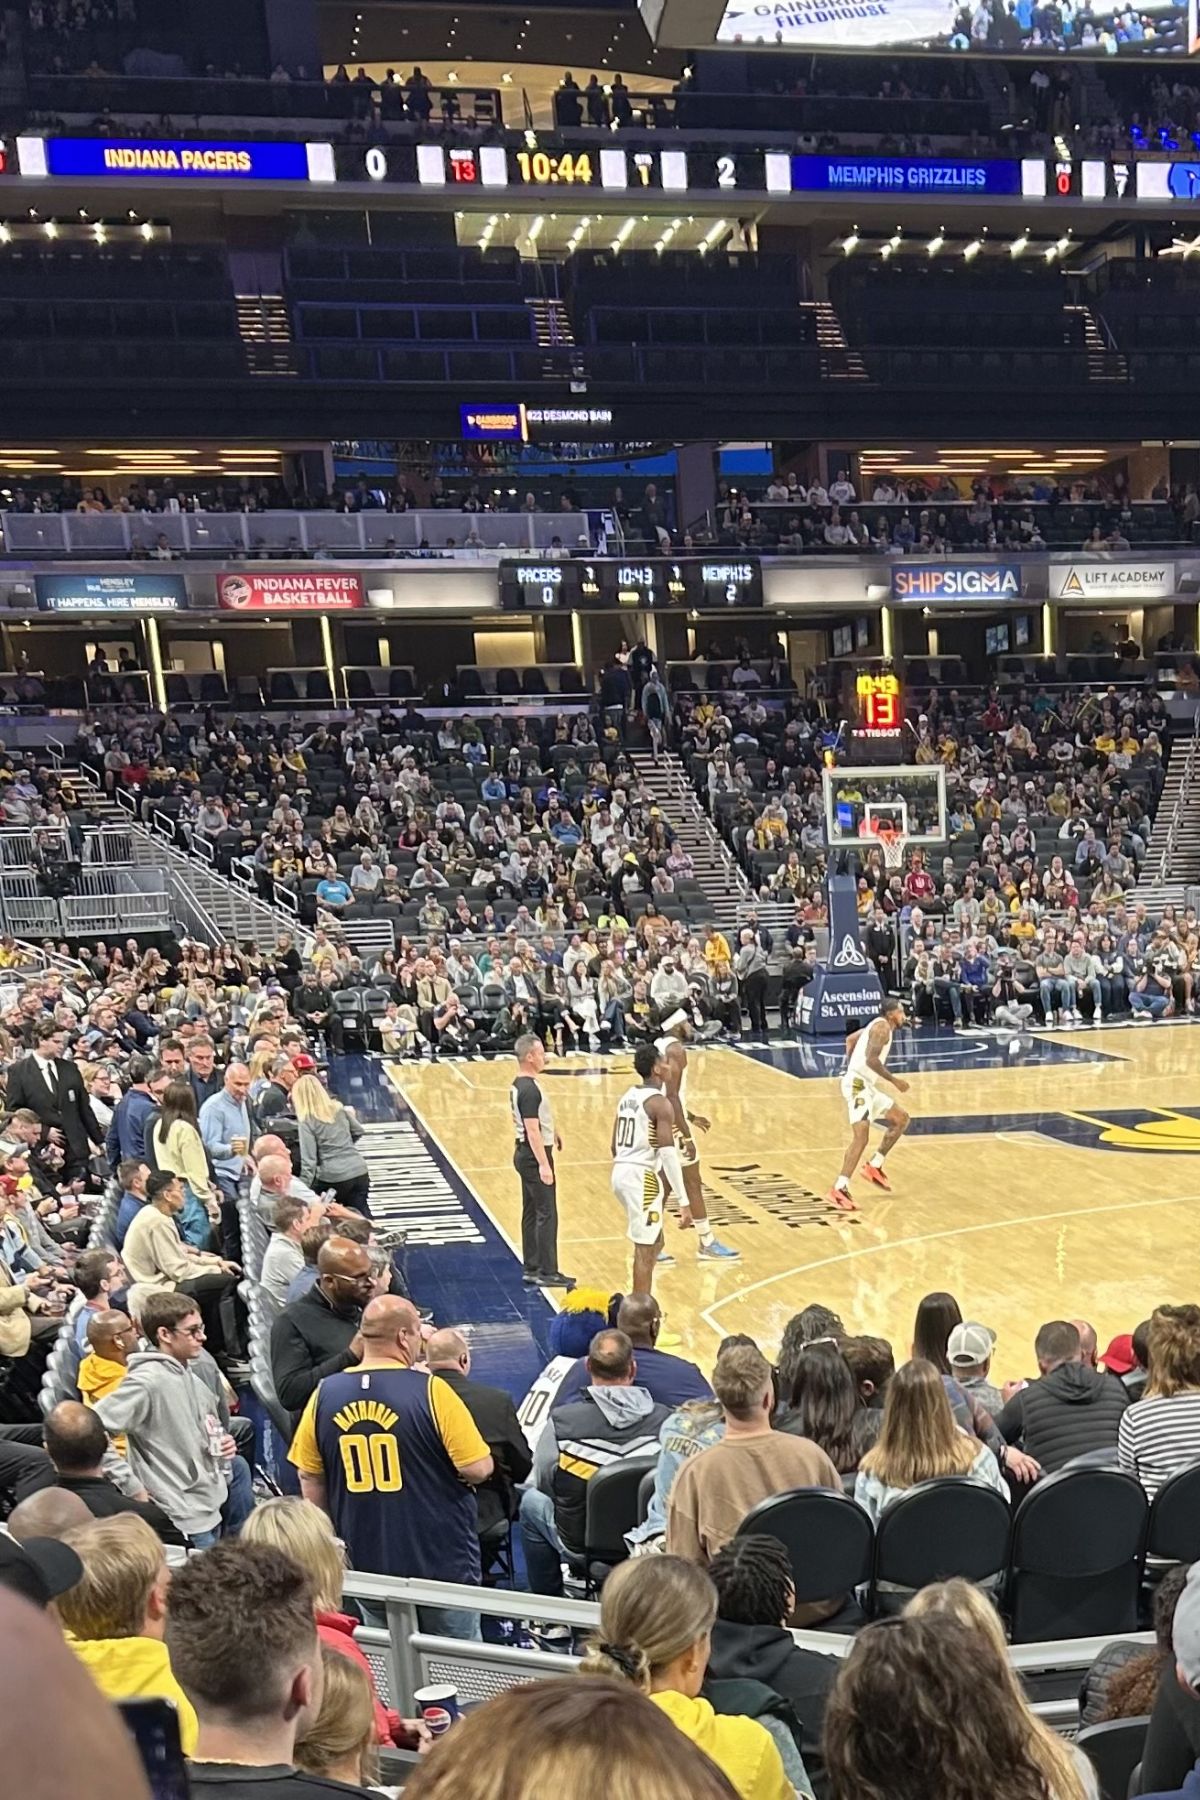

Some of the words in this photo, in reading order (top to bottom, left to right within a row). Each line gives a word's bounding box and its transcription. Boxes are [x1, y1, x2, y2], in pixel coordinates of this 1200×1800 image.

[776, 5, 890, 28] FIELDHOUSE
[104, 149, 180, 168] INDIANA
[182, 150, 252, 171] PACERS
[365, 148, 387, 181] 0
[517, 153, 593, 184] 10:44
[451, 160, 476, 181] 13
[716, 158, 736, 187] 2
[828, 165, 904, 186] MEMPHIS
[907, 167, 986, 187] GRIZZLIES
[543, 410, 588, 421] DESMOND
[517, 568, 562, 583] PACERS
[618, 567, 653, 584] 10:43
[702, 565, 752, 581] MEMPHIS
[1085, 572, 1108, 584] LIFT
[1111, 570, 1165, 583] ACADEMY
[253, 578, 315, 590] INDIANA
[316, 577, 359, 591] FEVER
[895, 570, 1019, 594] SHIPSIGMA
[264, 591, 352, 606] BASKETBALL
[542, 587, 553, 604] 0
[726, 584, 737, 601] 2
[46, 598, 56, 607] IT
[107, 598, 129, 608] HIRE
[867, 694, 893, 724] 13
[866, 728, 901, 738] TISSOT
[821, 988, 881, 1003] Ascension
[821, 1004, 838, 1017] St.
[617, 1116, 636, 1148] 00
[332, 1400, 399, 1432] MATHURIN
[339, 1433, 403, 1493] 00
